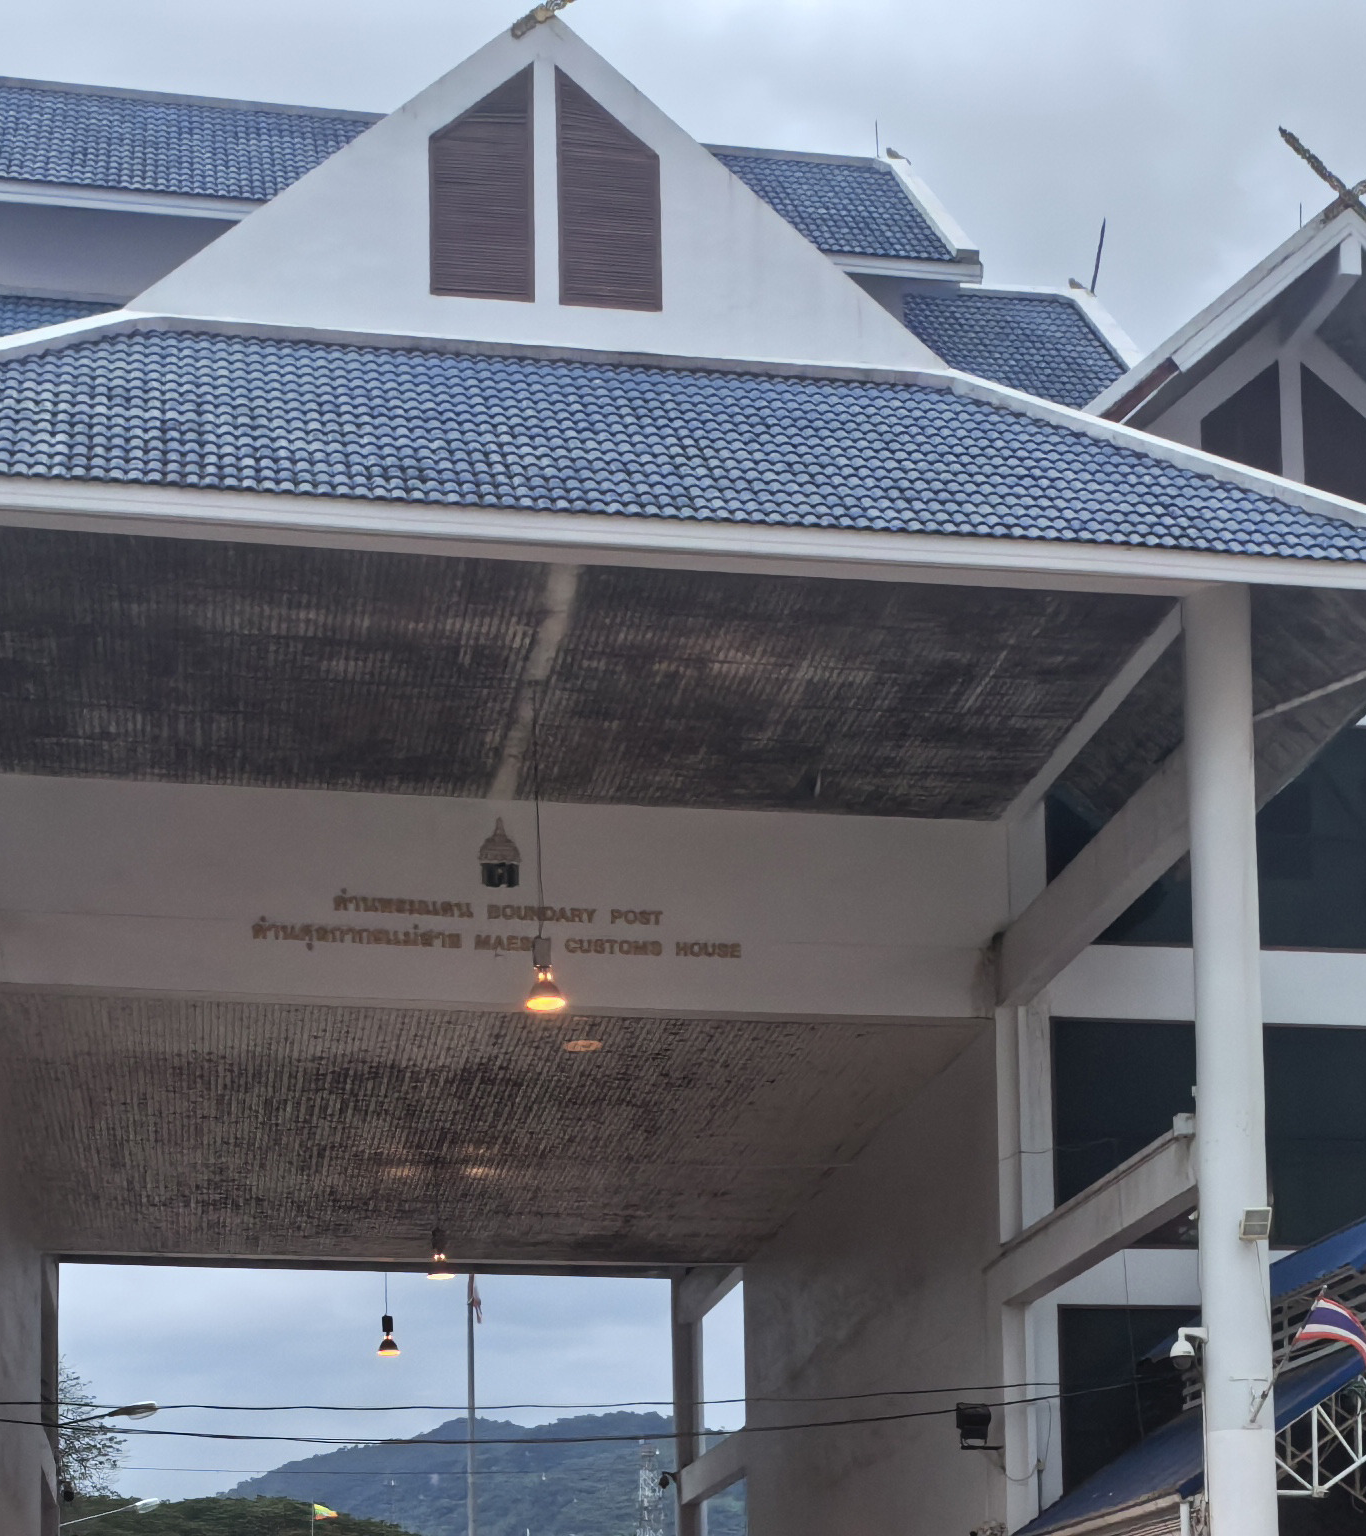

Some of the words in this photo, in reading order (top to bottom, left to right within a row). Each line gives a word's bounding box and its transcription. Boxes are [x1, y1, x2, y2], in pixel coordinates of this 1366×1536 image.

[486, 903, 597, 924] BOUNDARY
[610, 908, 664, 926] POST
[474, 933, 540, 953] MAES
[564, 937, 664, 957] CUSTOMS
[675, 941, 743, 959] HOUSE
